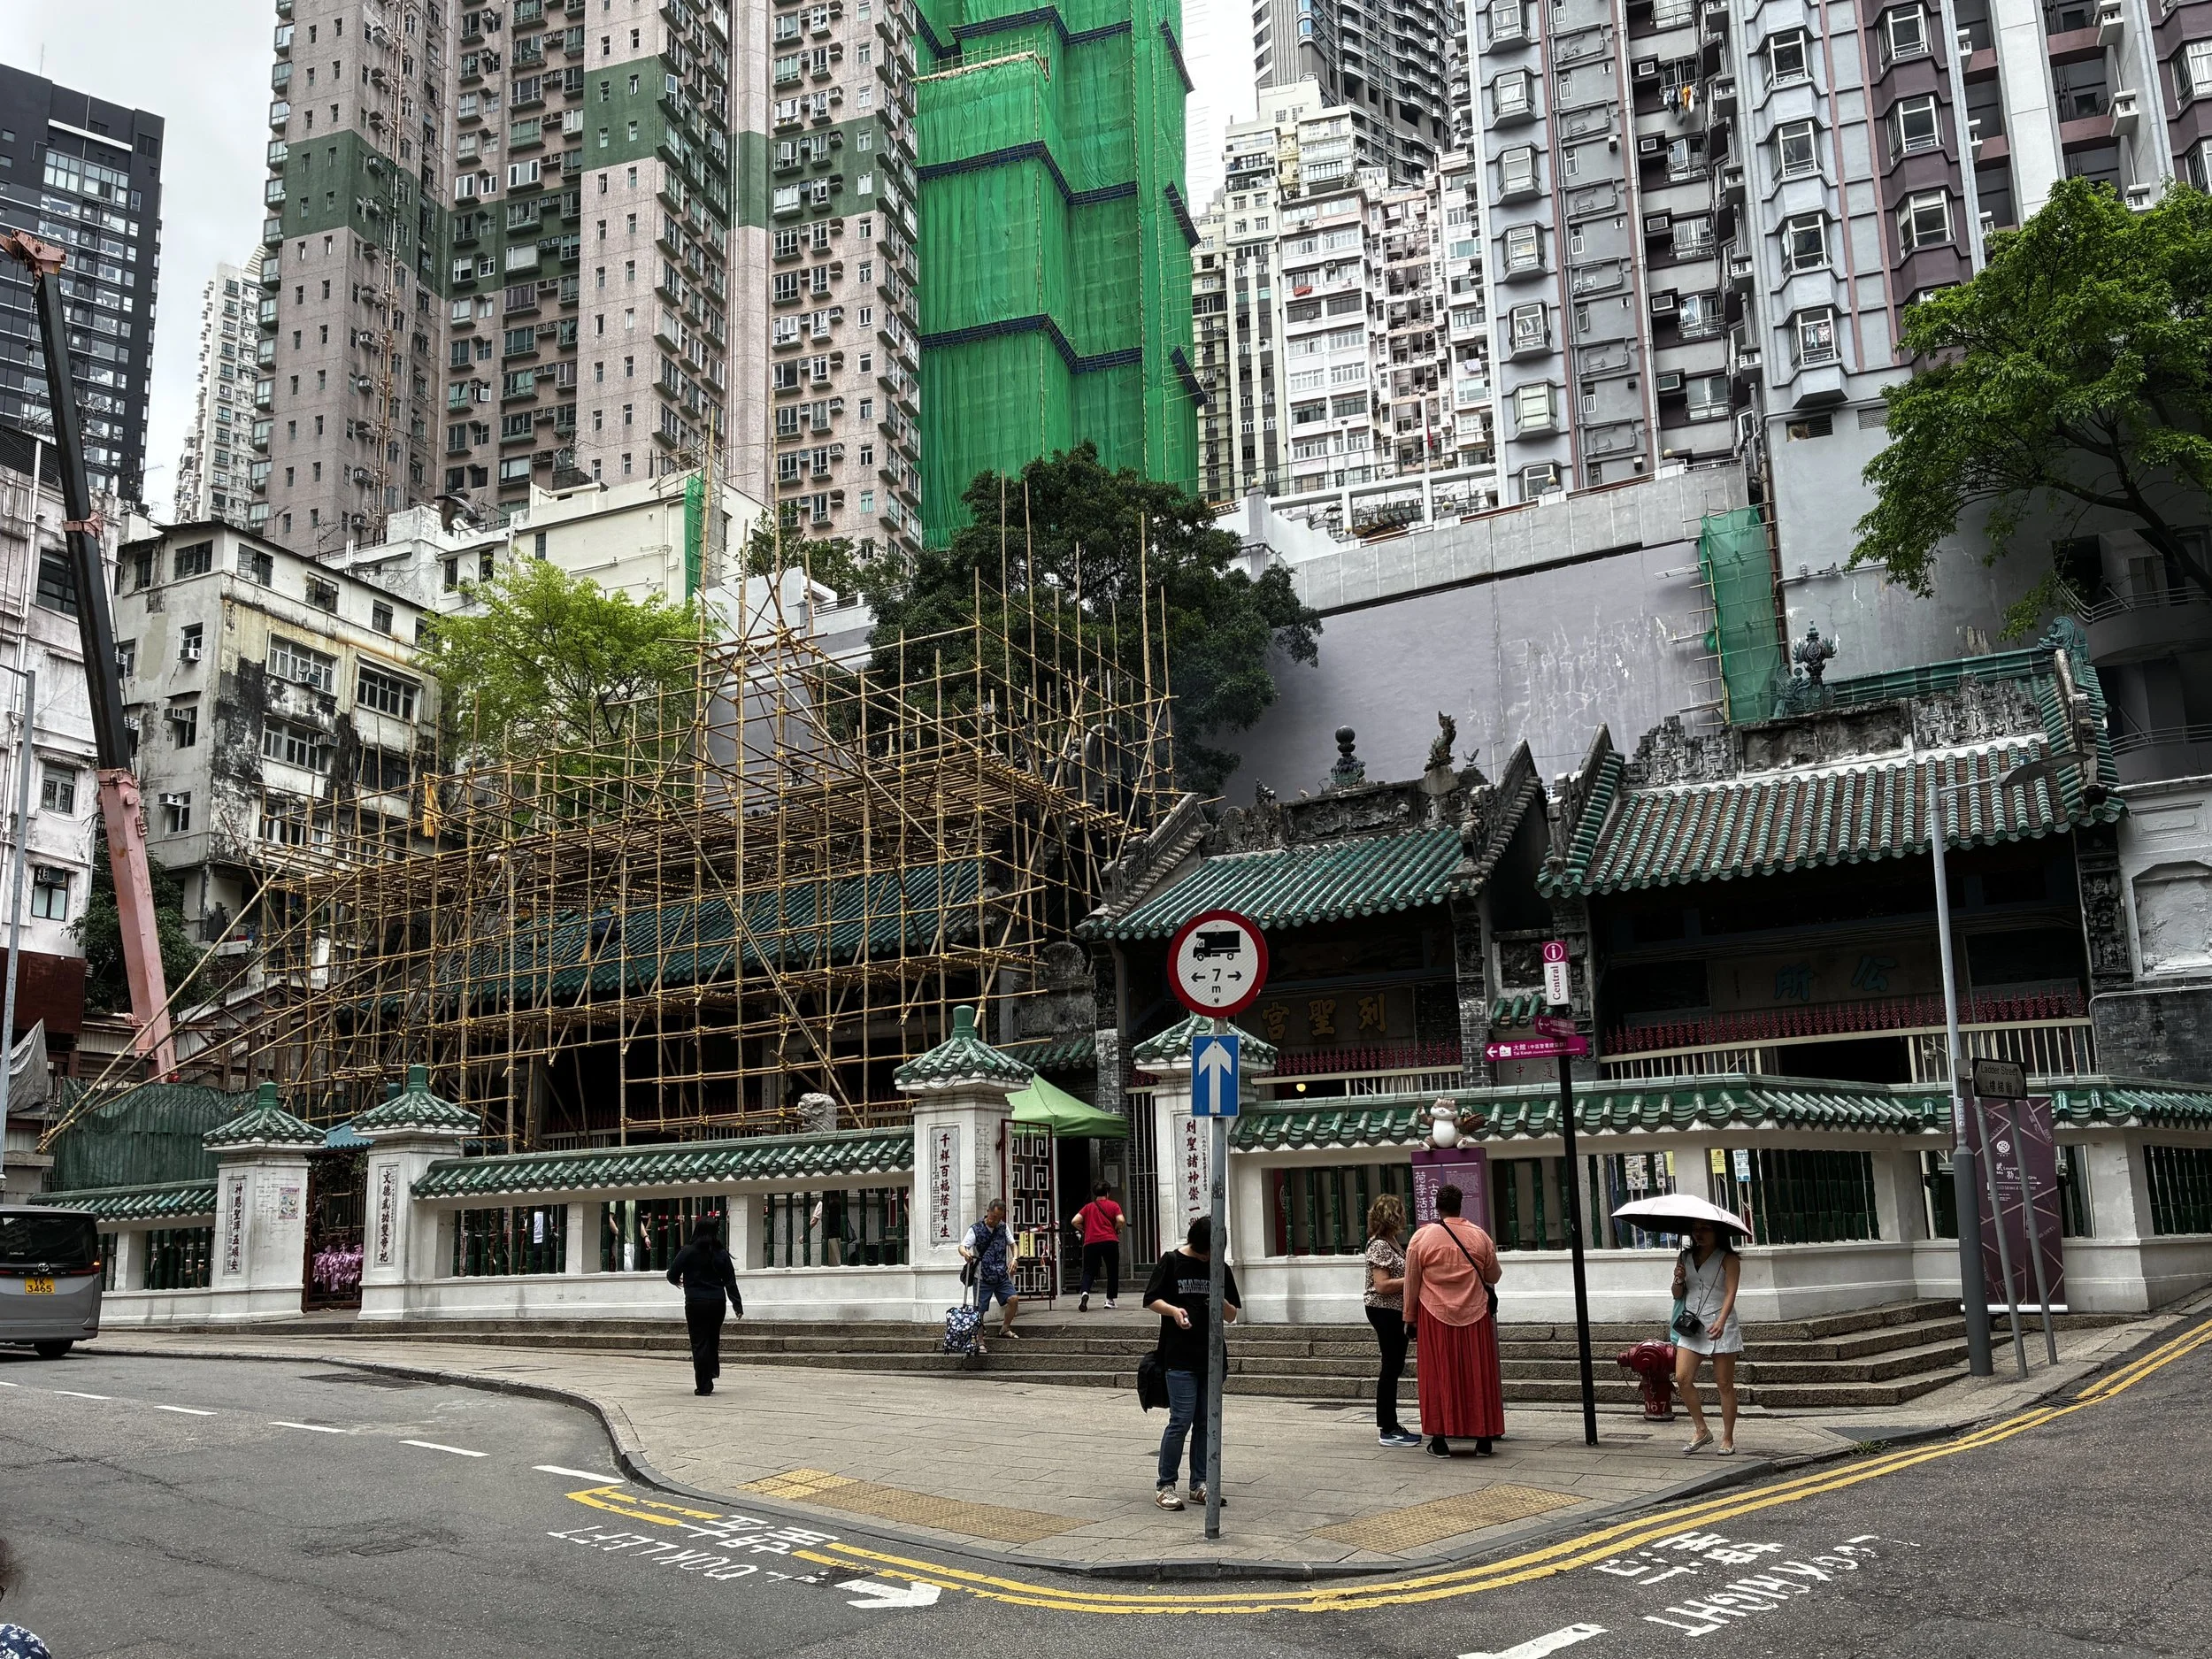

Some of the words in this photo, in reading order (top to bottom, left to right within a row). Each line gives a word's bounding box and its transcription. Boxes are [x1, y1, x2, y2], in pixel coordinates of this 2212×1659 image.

[1212, 968, 1221, 982] 7
[1552, 965, 1561, 1001] Central
[1981, 1064, 2000, 1074] Ladder
[2001, 1065, 2018, 1076] Street
[1415, 1171, 1429, 1221] 荷李活道
[547, 1525, 680, 1557] LEFT
[1769, 1535, 1920, 1582] LOOK
[652, 1549, 826, 1583] LOOK
[1642, 1575, 1811, 1637] RIGHT
